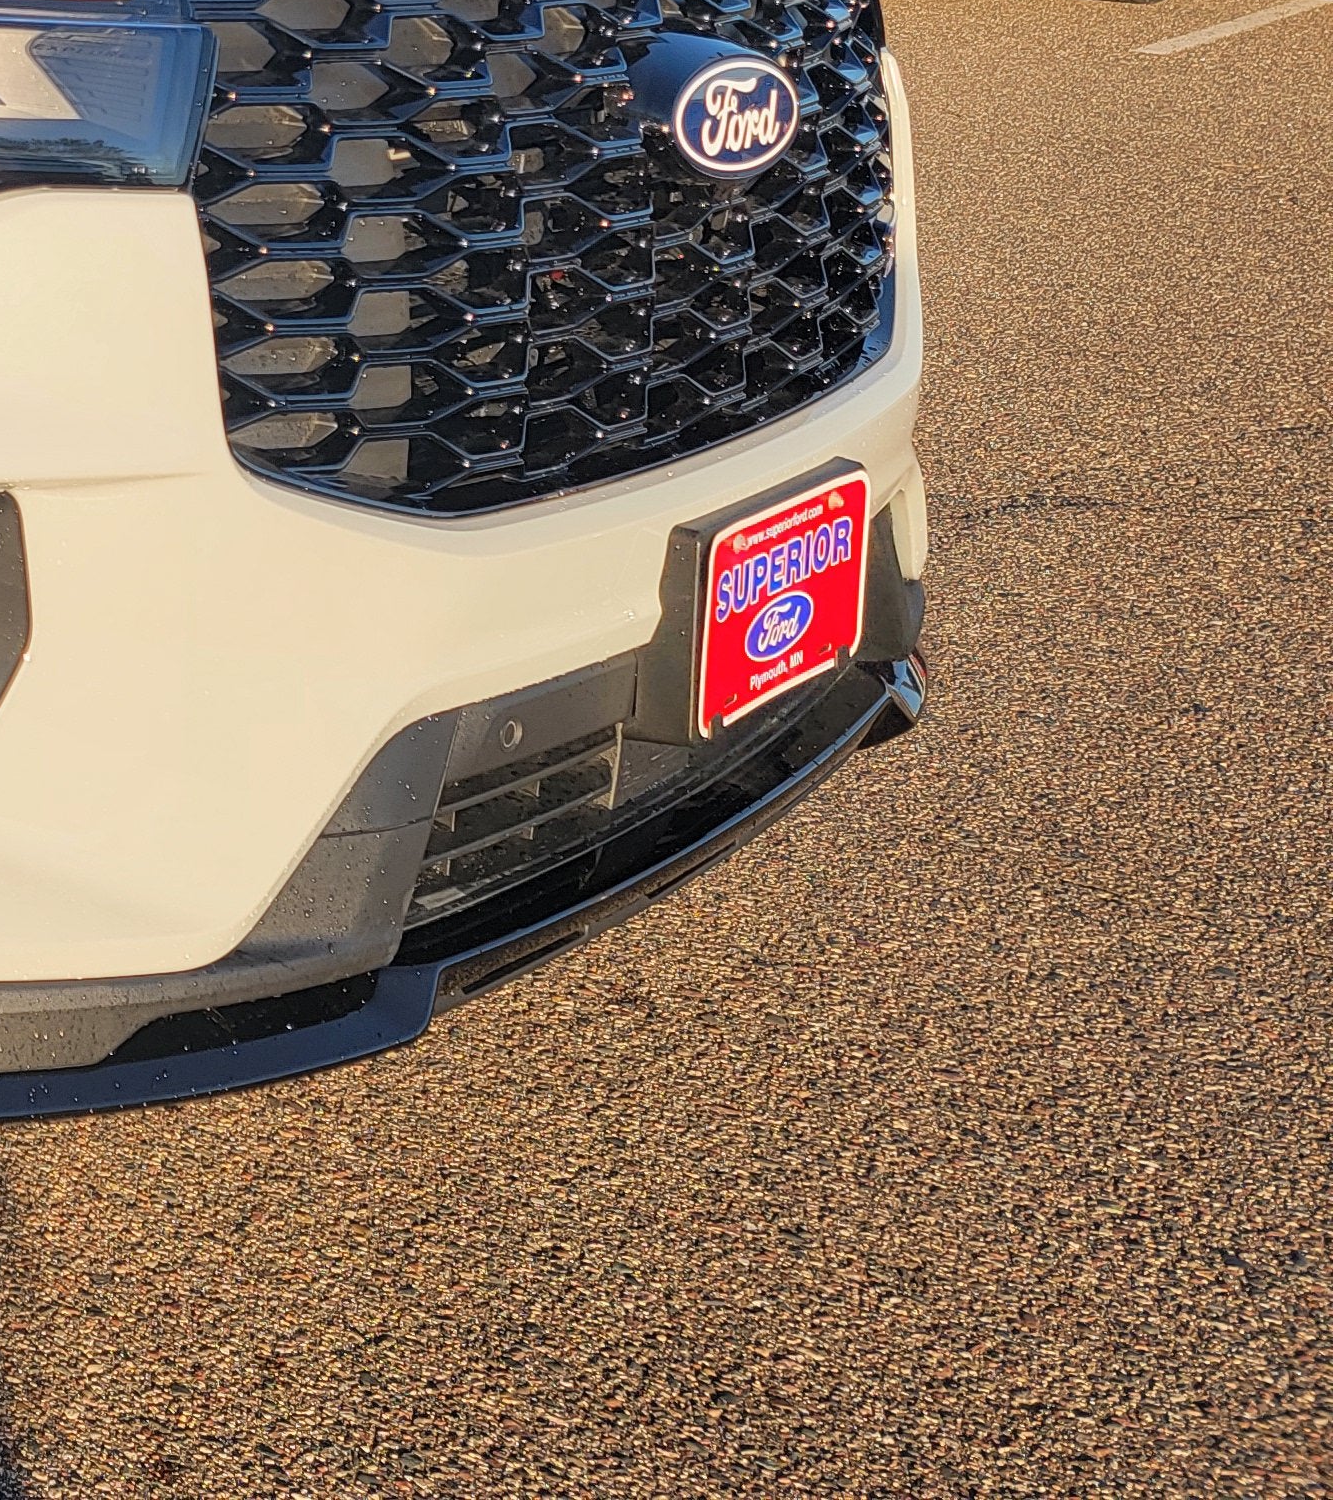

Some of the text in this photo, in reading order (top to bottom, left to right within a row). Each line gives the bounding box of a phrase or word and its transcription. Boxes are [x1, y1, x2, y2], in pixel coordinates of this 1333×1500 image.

[701, 77, 780, 157] Ford
[745, 504, 824, 548] www.superiorford.com
[715, 515, 853, 623] SUPERIOR
[757, 601, 802, 652] Ford
[749, 649, 804, 691] Plymouth, MN
